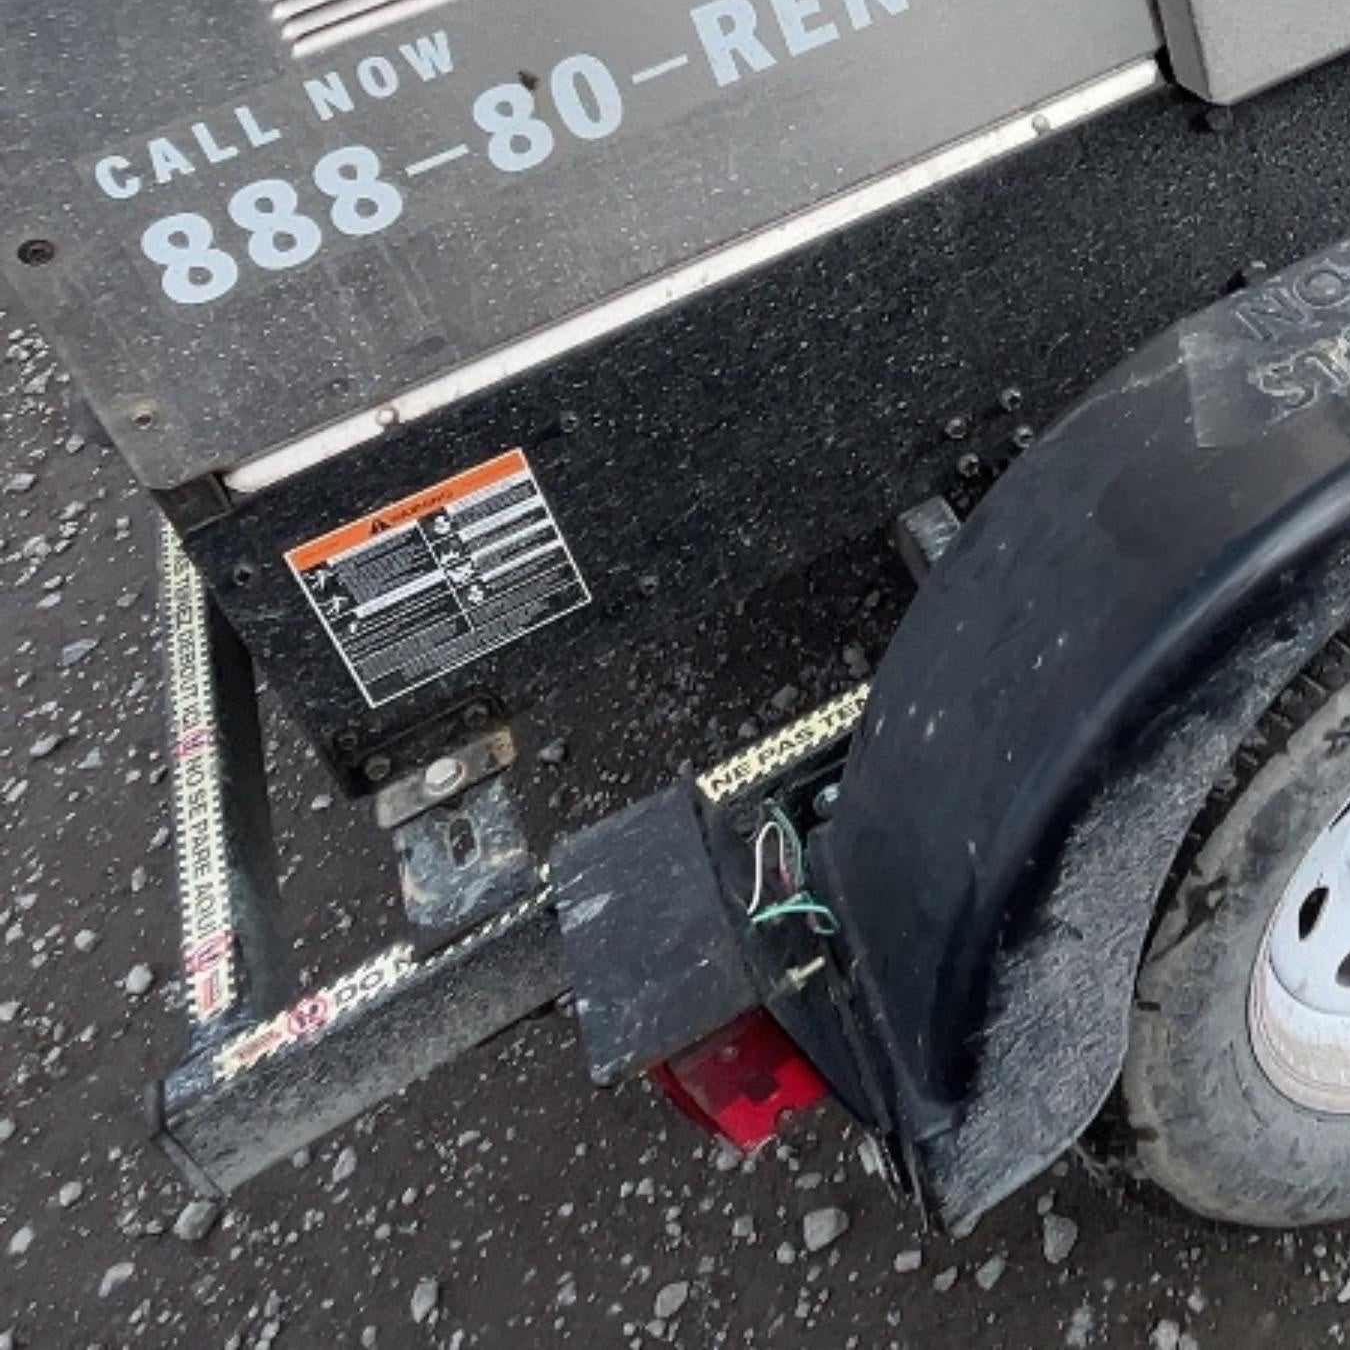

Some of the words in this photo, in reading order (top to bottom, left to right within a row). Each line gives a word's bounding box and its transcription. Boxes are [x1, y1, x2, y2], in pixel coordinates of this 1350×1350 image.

[94, 103, 281, 202] CALL
[302, 30, 456, 122] NOW
[710, 761, 752, 792] NE
[757, 727, 814, 767] PAS
[190, 818, 211, 879] PARE
[333, 969, 385, 1007] DO
